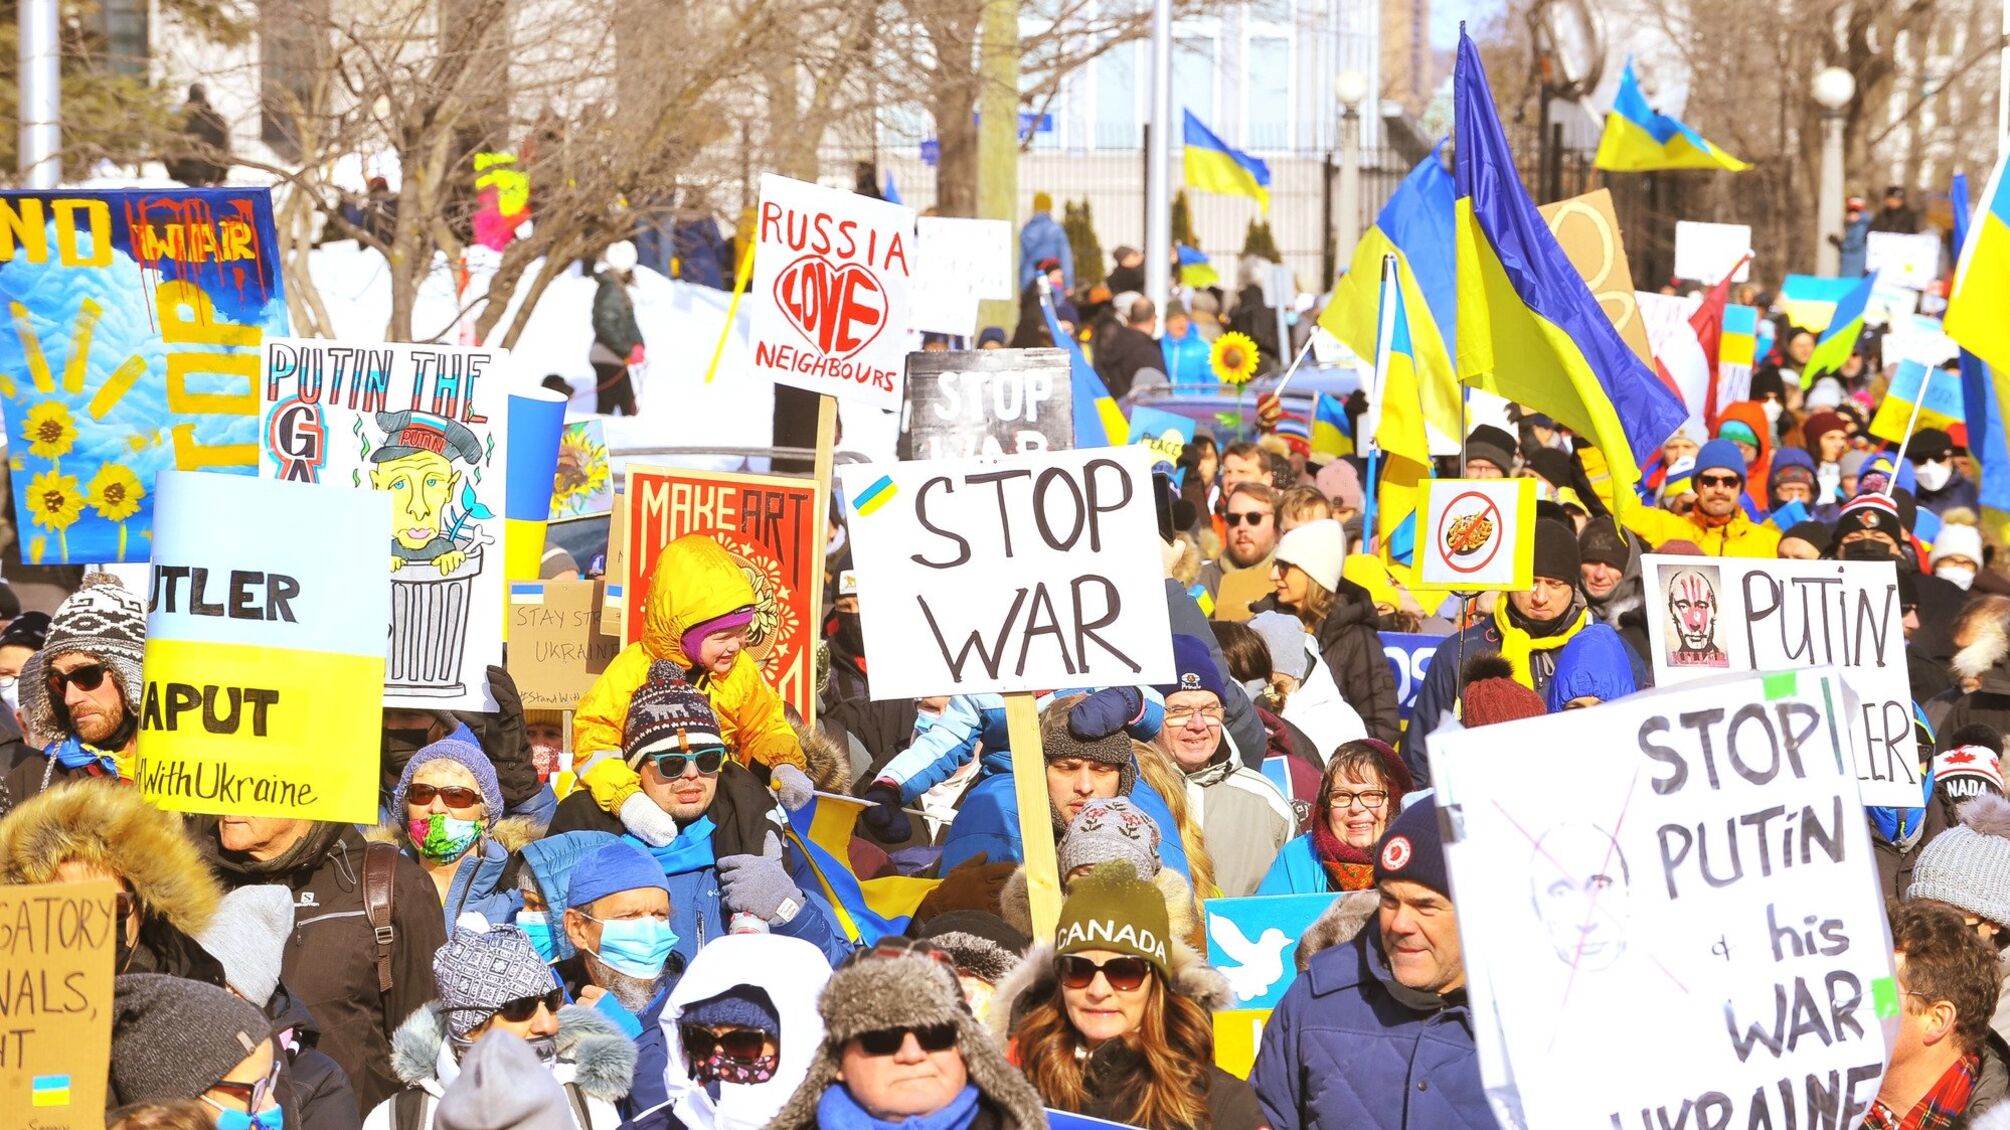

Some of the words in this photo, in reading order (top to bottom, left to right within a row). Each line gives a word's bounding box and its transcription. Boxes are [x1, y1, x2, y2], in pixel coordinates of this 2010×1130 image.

[0, 198, 113, 268] NO
[131, 220, 256, 263] WAR
[762, 201, 909, 277] RUSSIA
[782, 262, 880, 355] LOVE
[267, 343, 394, 413] PUTIN
[410, 351, 491, 424] THE
[756, 340, 897, 392] NEIGHBOURS
[934, 368, 1053, 423] STOP
[399, 429, 445, 455] PUTIN
[640, 480, 737, 578] MAKE
[741, 489, 809, 592] ART
[910, 458, 1134, 569] STOP
[517, 606, 565, 629] STAY
[916, 574, 1142, 683] WAR
[1639, 702, 1821, 796] STOP
[1057, 919, 1167, 966] CANADA
[1765, 903, 1850, 962] his
[1723, 970, 1864, 1063] WAR
